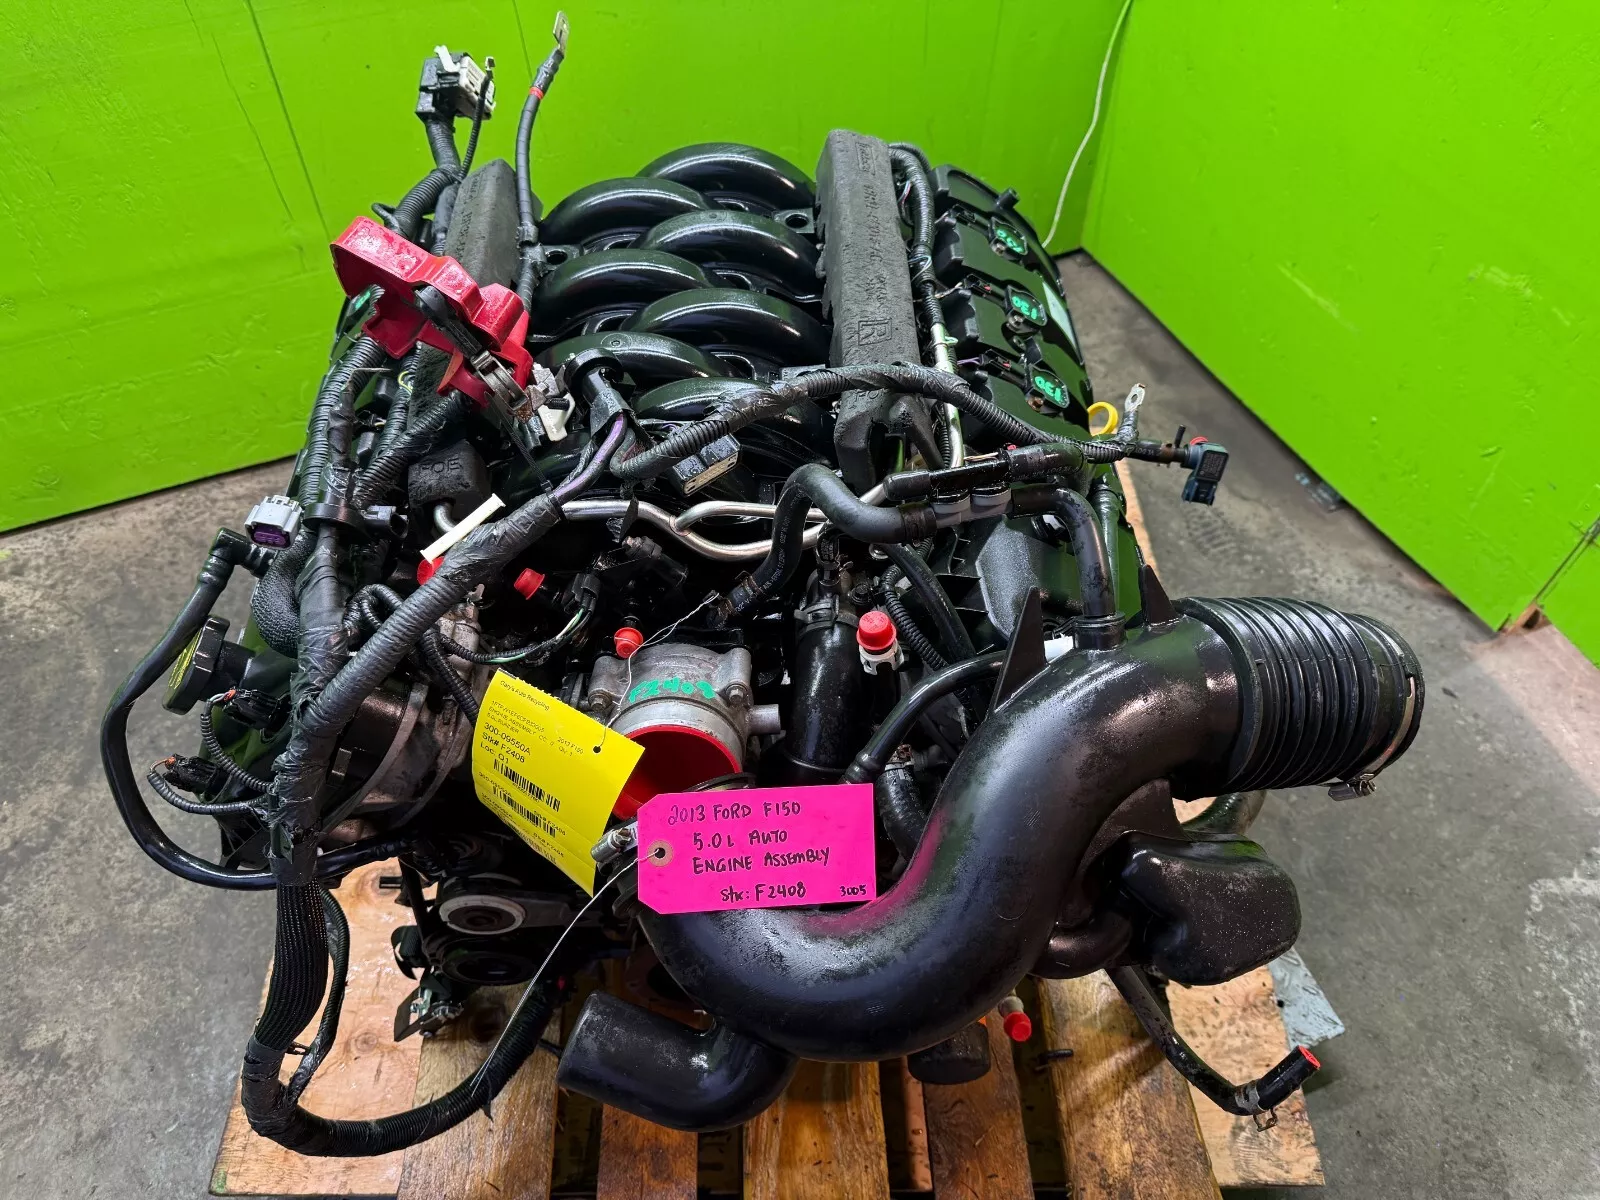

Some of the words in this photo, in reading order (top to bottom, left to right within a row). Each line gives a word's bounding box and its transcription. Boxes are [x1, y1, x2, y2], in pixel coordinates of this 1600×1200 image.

[1034, 376, 1063, 402] 130
[482, 731, 500, 747] Stk#
[500, 743, 525, 764] F2408
[484, 722, 531, 756] 300-09550A
[667, 804, 706, 826] 2013
[713, 803, 752, 822] FORD
[762, 801, 802, 818] F150
[749, 829, 788, 846] AUTO
[692, 856, 753, 875] ENGINE
[755, 881, 807, 901] F2408
[839, 884, 867, 897] 3005
